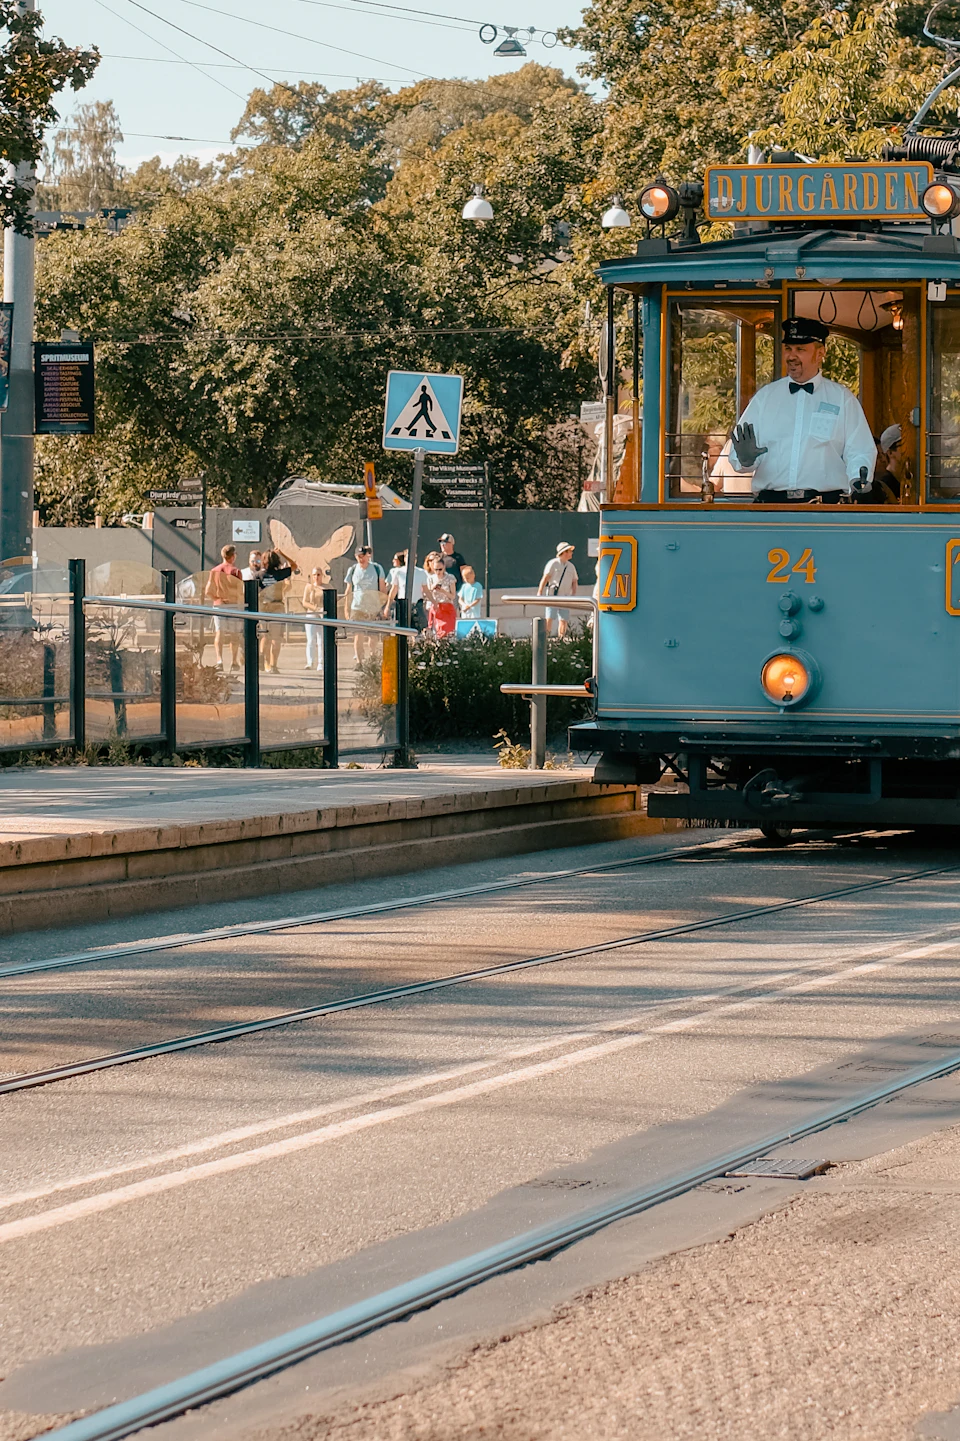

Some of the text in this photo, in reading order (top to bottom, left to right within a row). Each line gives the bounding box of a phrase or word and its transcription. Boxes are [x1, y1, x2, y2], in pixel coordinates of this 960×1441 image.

[716, 172, 921, 212] DJURGÅRDEN
[41, 354, 89, 362] SPRITMUSEUM
[766, 548, 818, 584] 24
